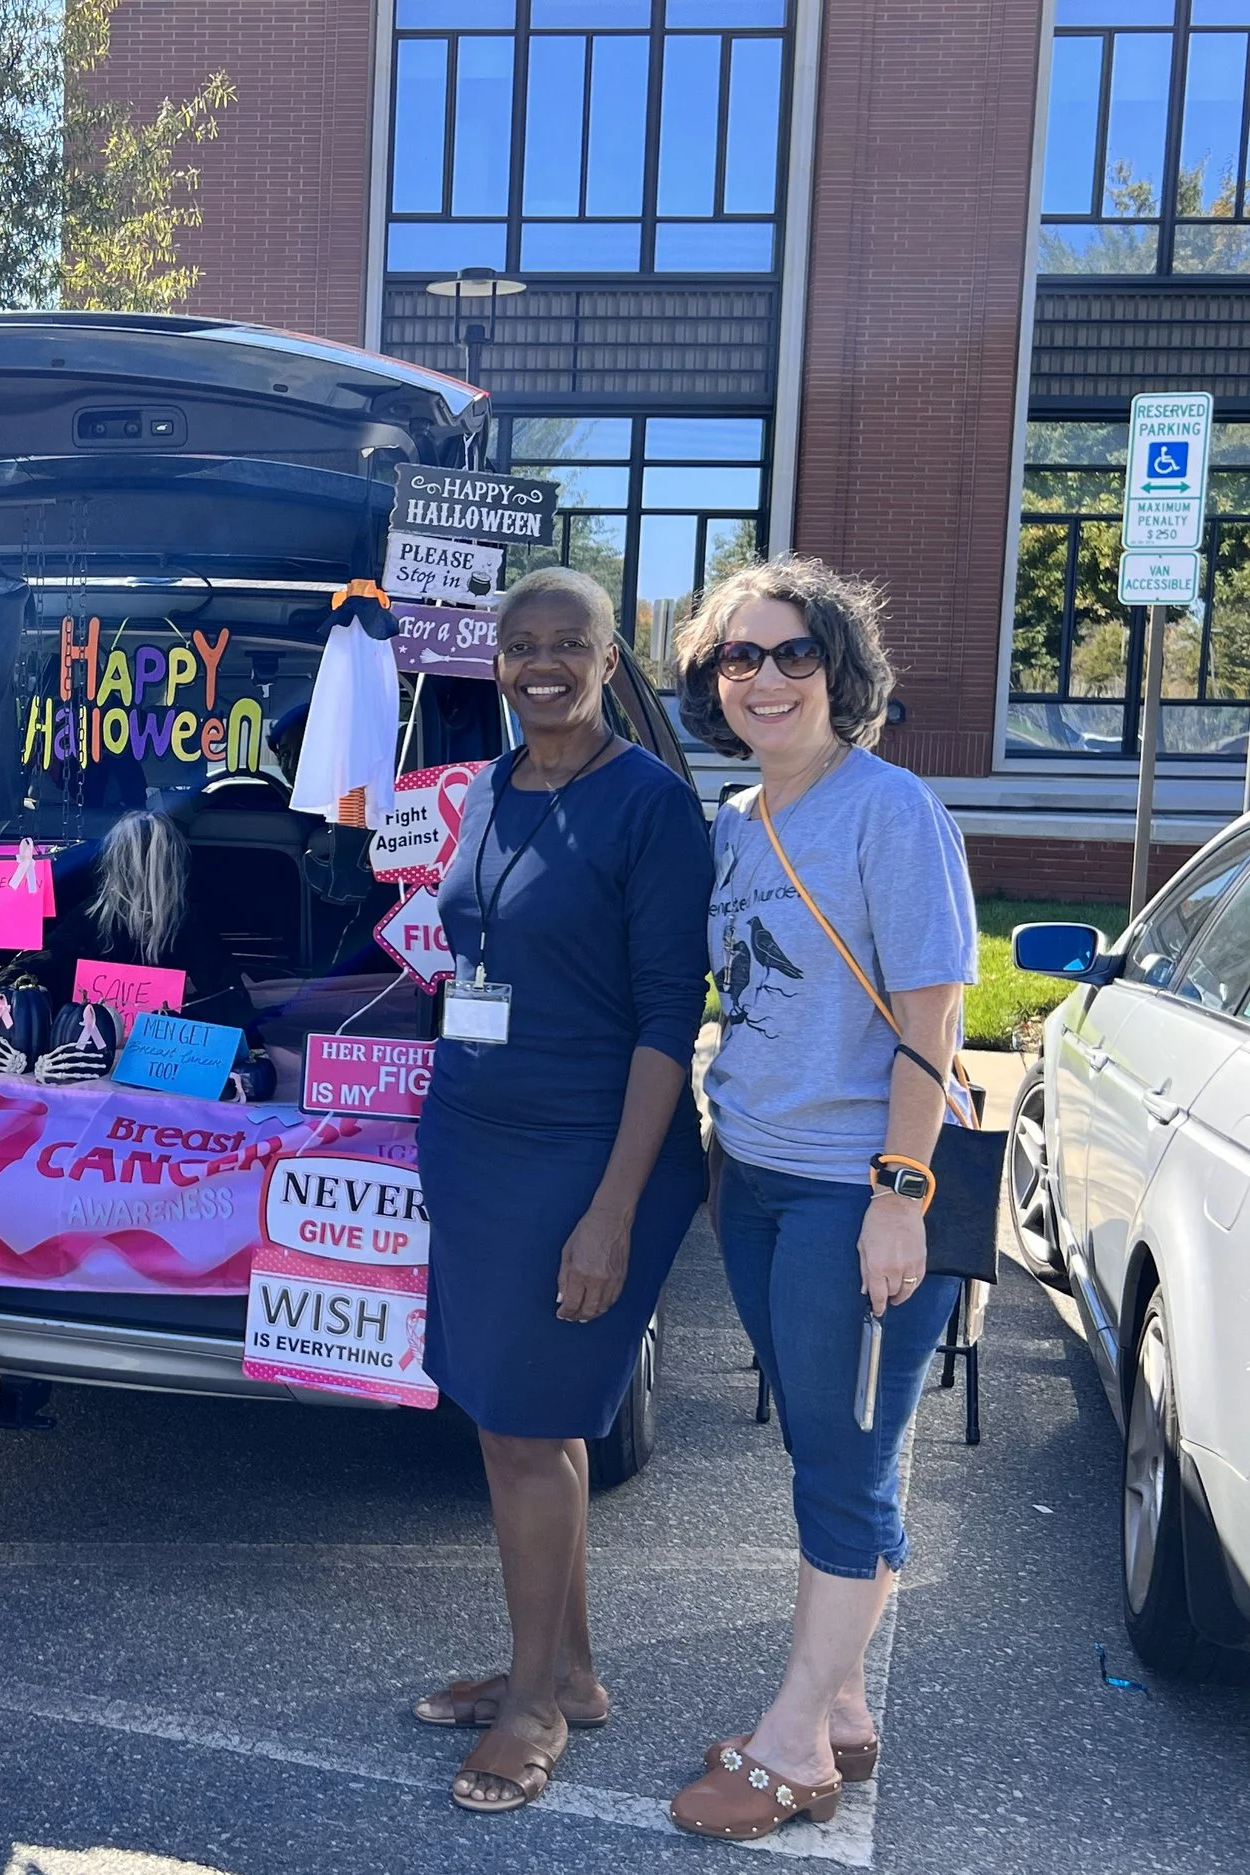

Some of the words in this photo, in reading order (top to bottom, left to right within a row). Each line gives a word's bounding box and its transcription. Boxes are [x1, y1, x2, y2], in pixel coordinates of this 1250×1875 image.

[1137, 403, 1206, 419] RESERVED
[1139, 422, 1201, 437] PARKING
[442, 477, 515, 505] HAPPY
[406, 499, 542, 538] HALLOWEEN
[1137, 502, 1191, 513] MAXIMUM
[1137, 515, 1189, 526] PENALTY
[400, 543, 475, 570] PLEASE
[1149, 565, 1171, 576] VAN
[396, 566, 436, 593] Stop
[443, 572, 461, 588] in
[1125, 578, 1193, 591] ACCESSIBLE
[398, 615, 435, 640] For
[437, 621, 450, 640] a
[456, 617, 498, 649] SPE
[60, 616, 230, 711] HAPPY
[376, 828, 439, 852] Against
[93, 975, 152, 1009] SAVE
[143, 1017, 176, 1041] MEN
[179, 1023, 215, 1047] GET
[322, 1041, 367, 1061] HER
[371, 1044, 436, 1067] FIGHT
[149, 1062, 179, 1081] TOO!
[311, 1081, 334, 1104] IS
[340, 1083, 377, 1107] MY
[378, 1065, 432, 1096] FIG
[106, 1115, 248, 1154] Breast
[67, 1186, 234, 1228] AWARENESS
[281, 1171, 431, 1222] NEVER
[299, 1219, 364, 1250] GIVE
[372, 1231, 410, 1255] UP
[261, 1284, 391, 1344] WISH
[253, 1331, 271, 1350] IS
[276, 1335, 394, 1369] EVERYTHING
